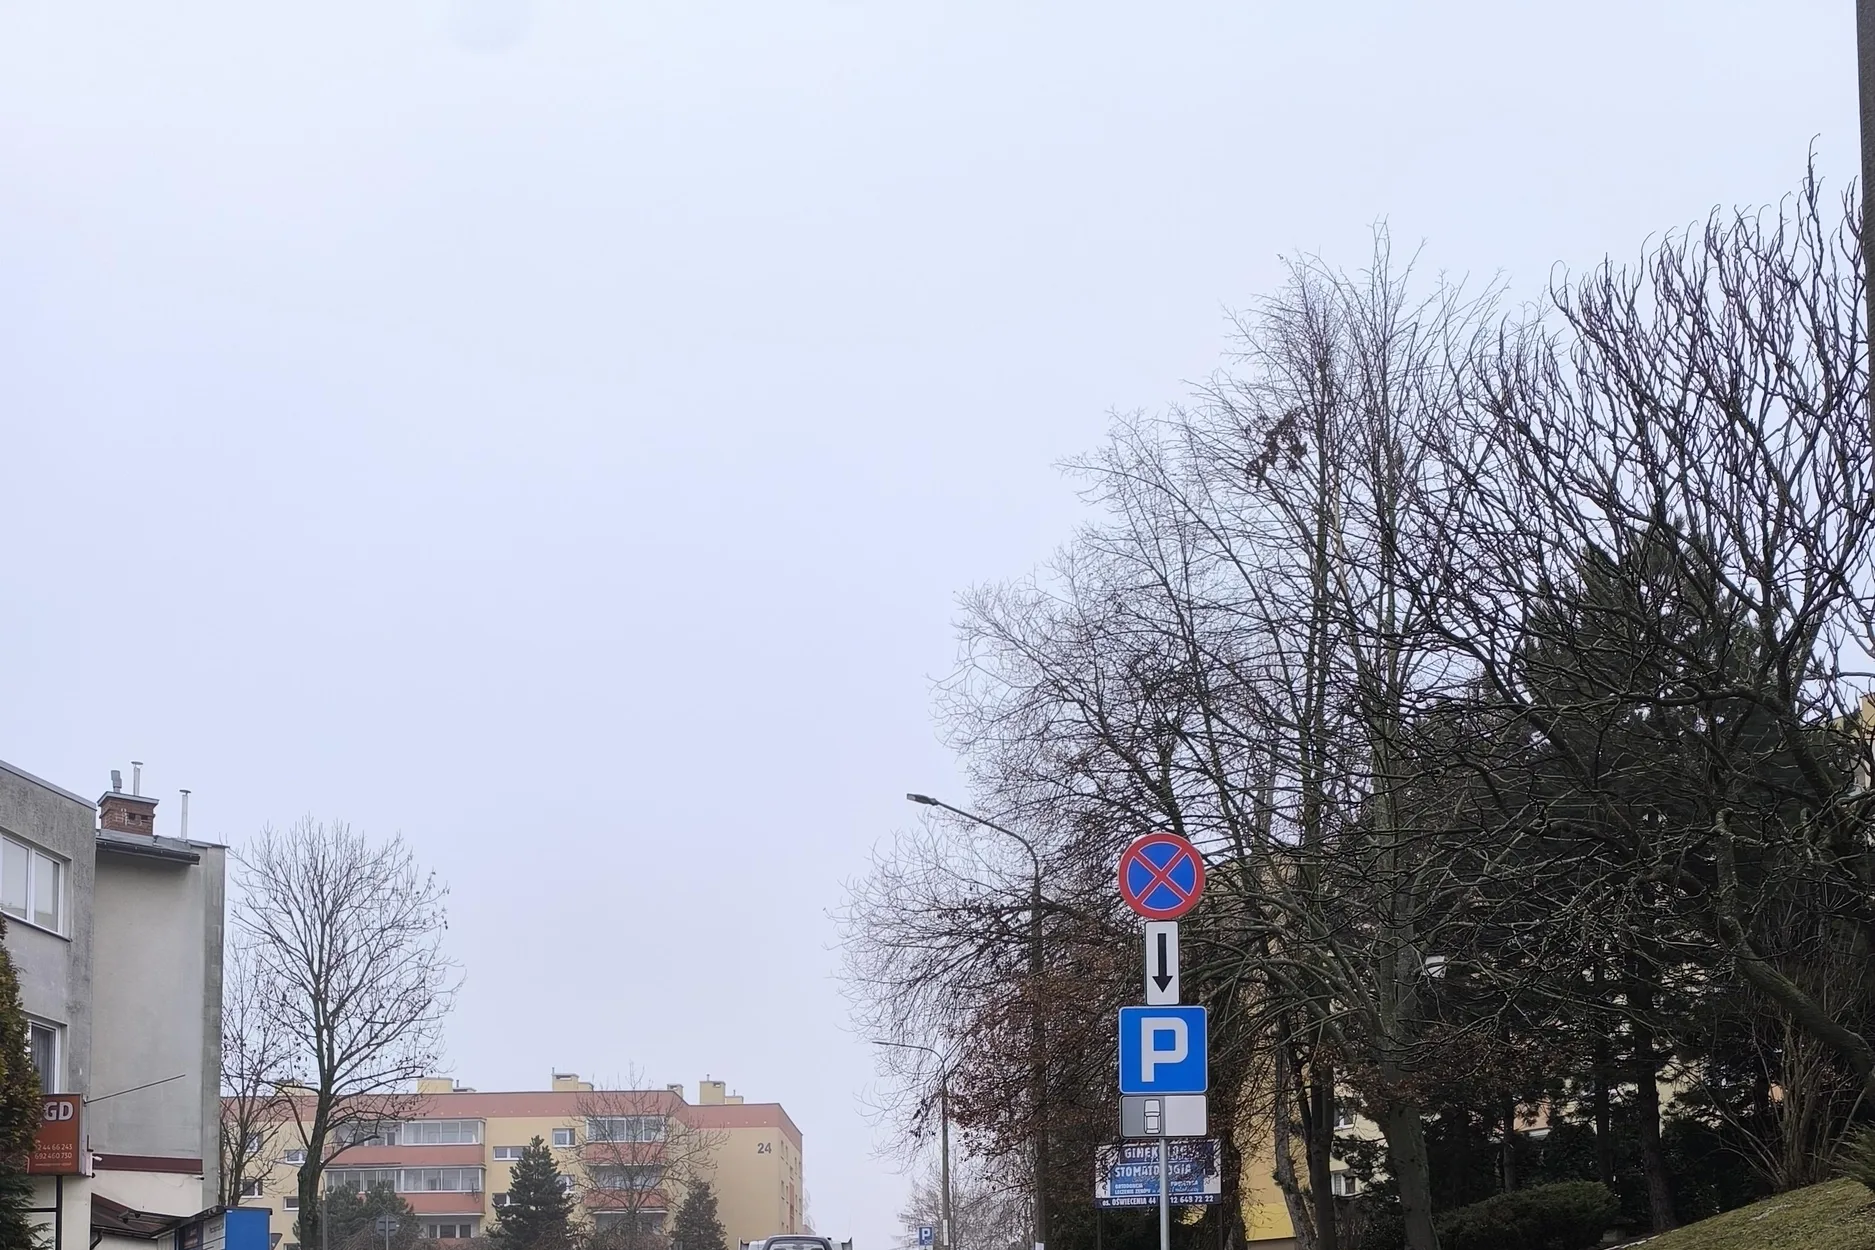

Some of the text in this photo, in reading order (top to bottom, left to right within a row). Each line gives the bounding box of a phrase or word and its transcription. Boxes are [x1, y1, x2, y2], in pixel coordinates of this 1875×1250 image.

[1140, 1016, 1189, 1083] P
[44, 1102, 74, 1120] GD
[757, 1142, 772, 1154] 24
[1115, 1164, 1191, 1177] STOMATOOGIA
[922, 1228, 930, 1240] P
